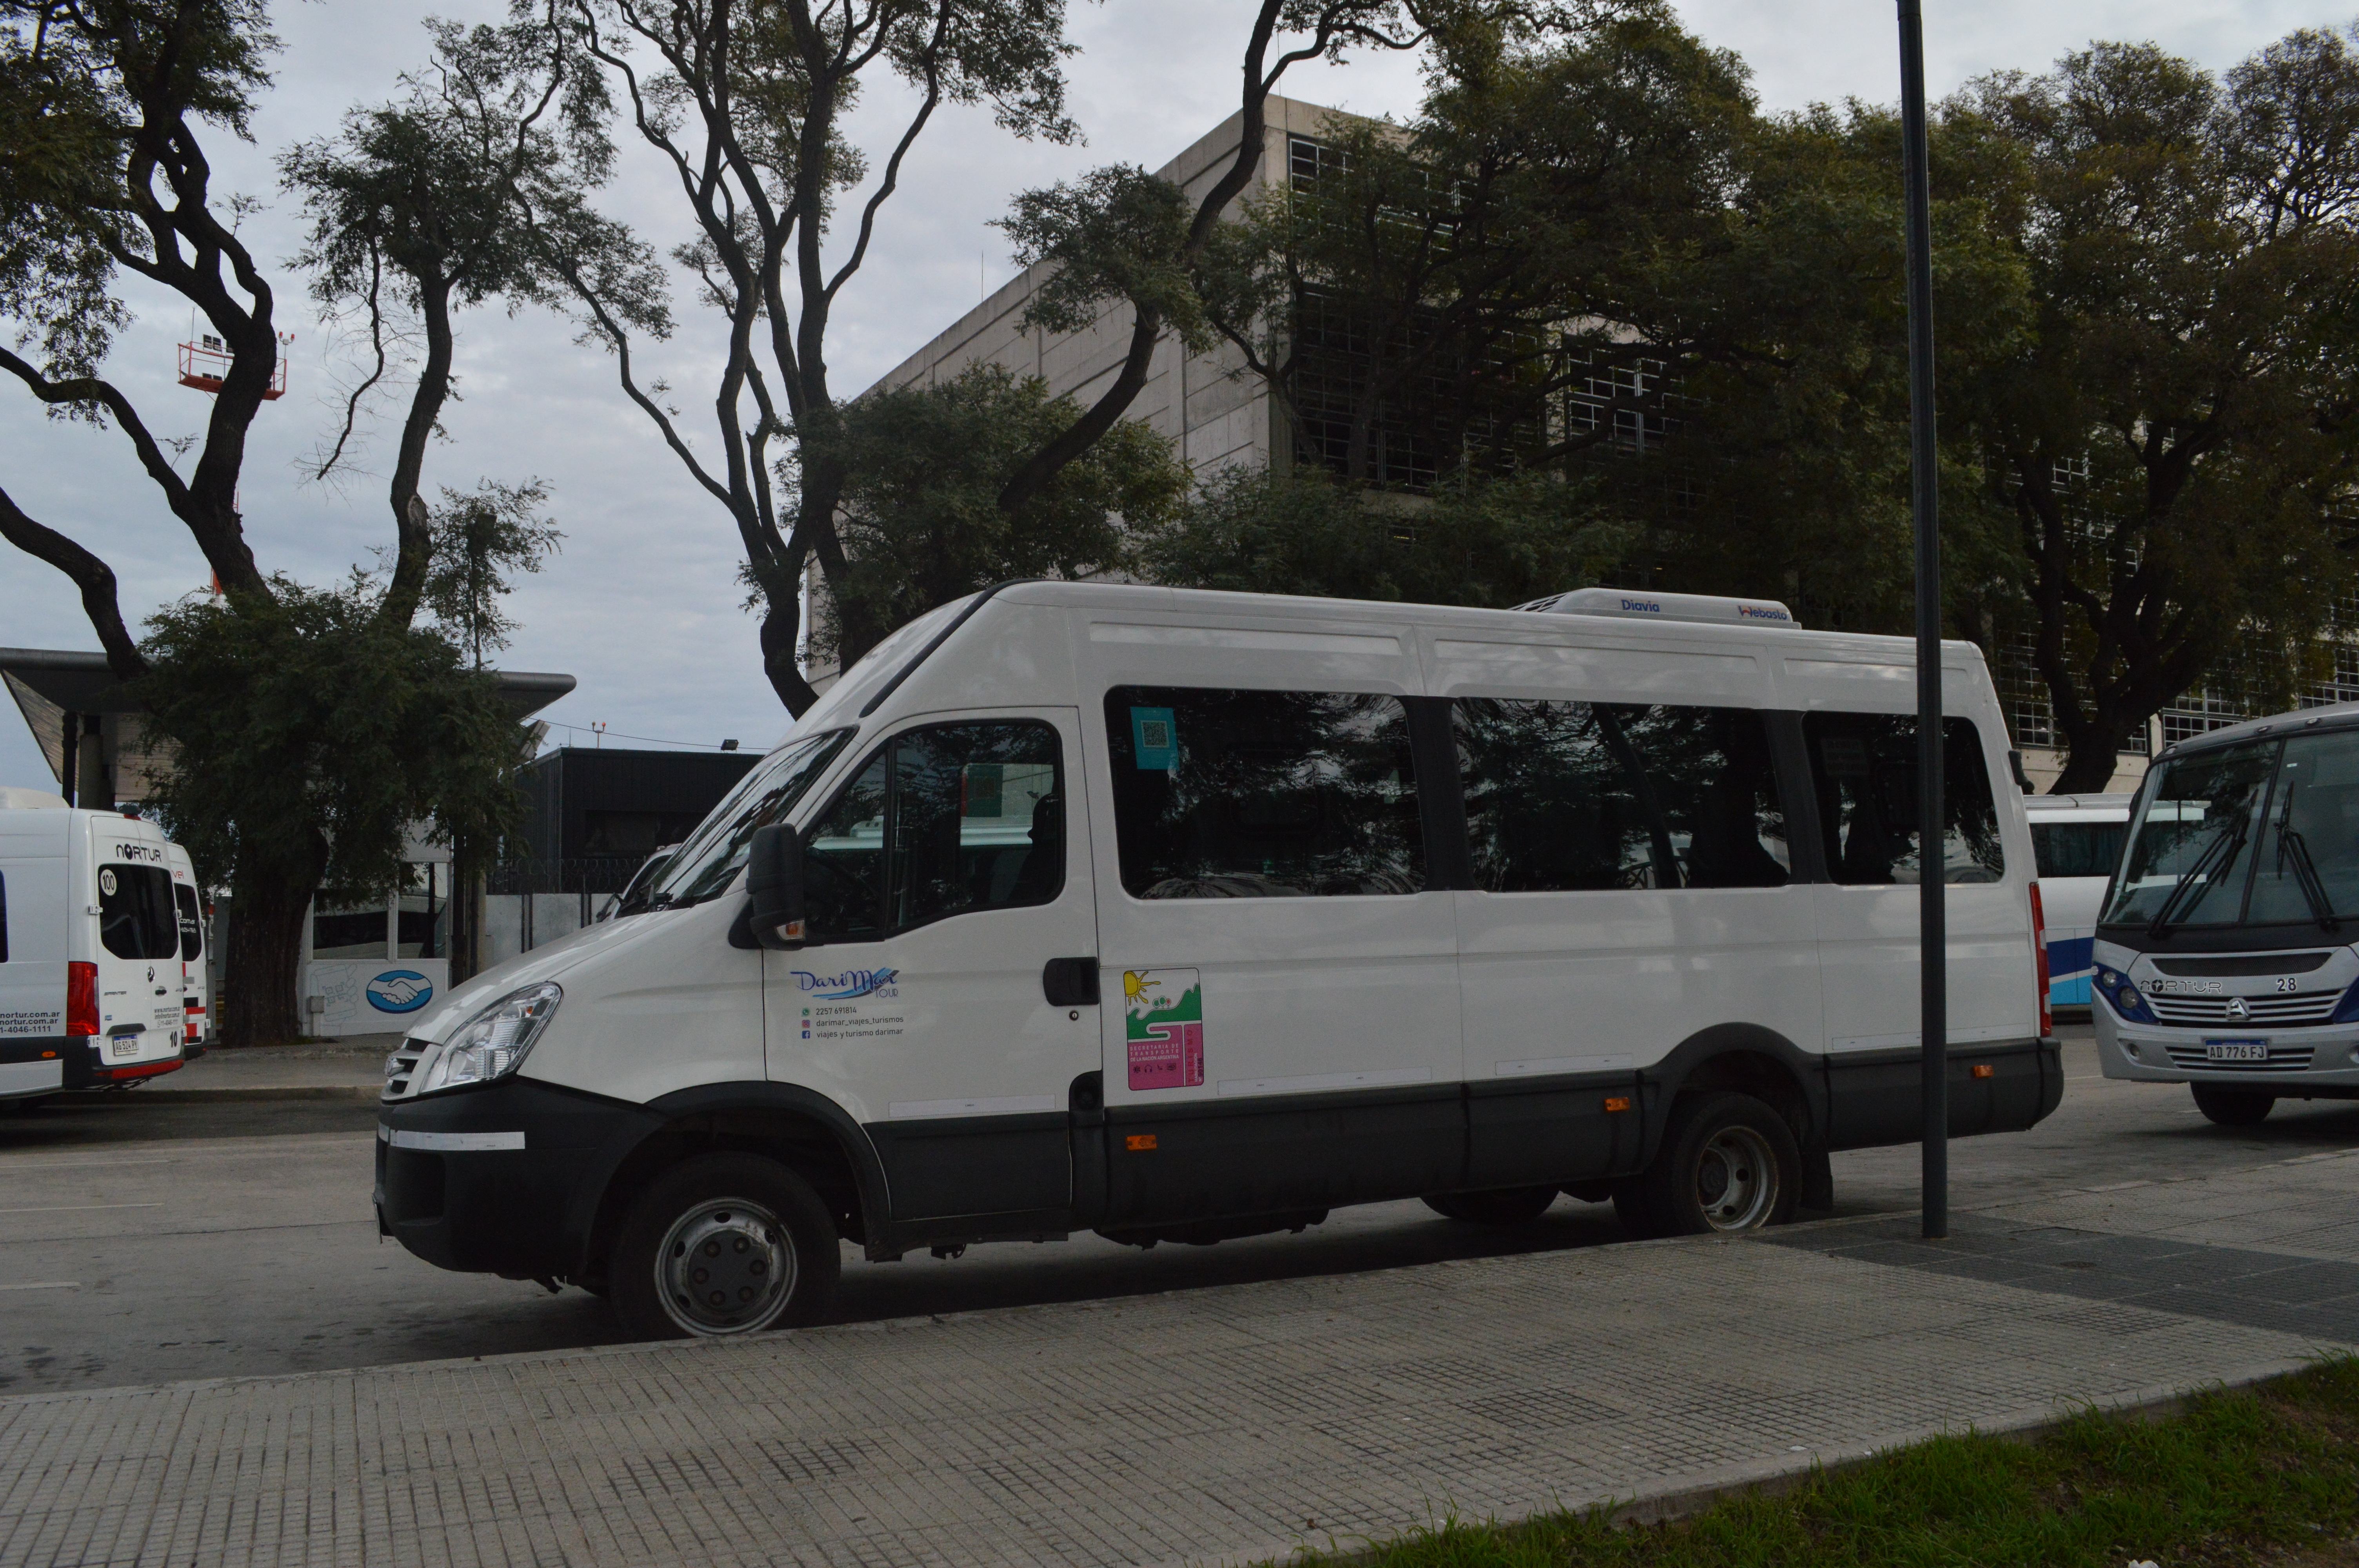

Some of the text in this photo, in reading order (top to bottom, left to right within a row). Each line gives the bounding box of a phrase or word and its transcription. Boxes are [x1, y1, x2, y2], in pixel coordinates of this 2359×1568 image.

[1621, 599, 1659, 612] Diavia
[1738, 605, 1787, 620] Webasto
[103, 874, 114, 890] 100
[790, 970, 897, 991] DariMar
[2276, 978, 2297, 992] 28
[875, 988, 898, 998] TOUR
[170, 1031, 178, 1048] 10
[817, 1031, 838, 1039] viajes
[122, 1040, 131, 1050] 524
[2210, 1046, 2264, 1058] AD 776 FJ
